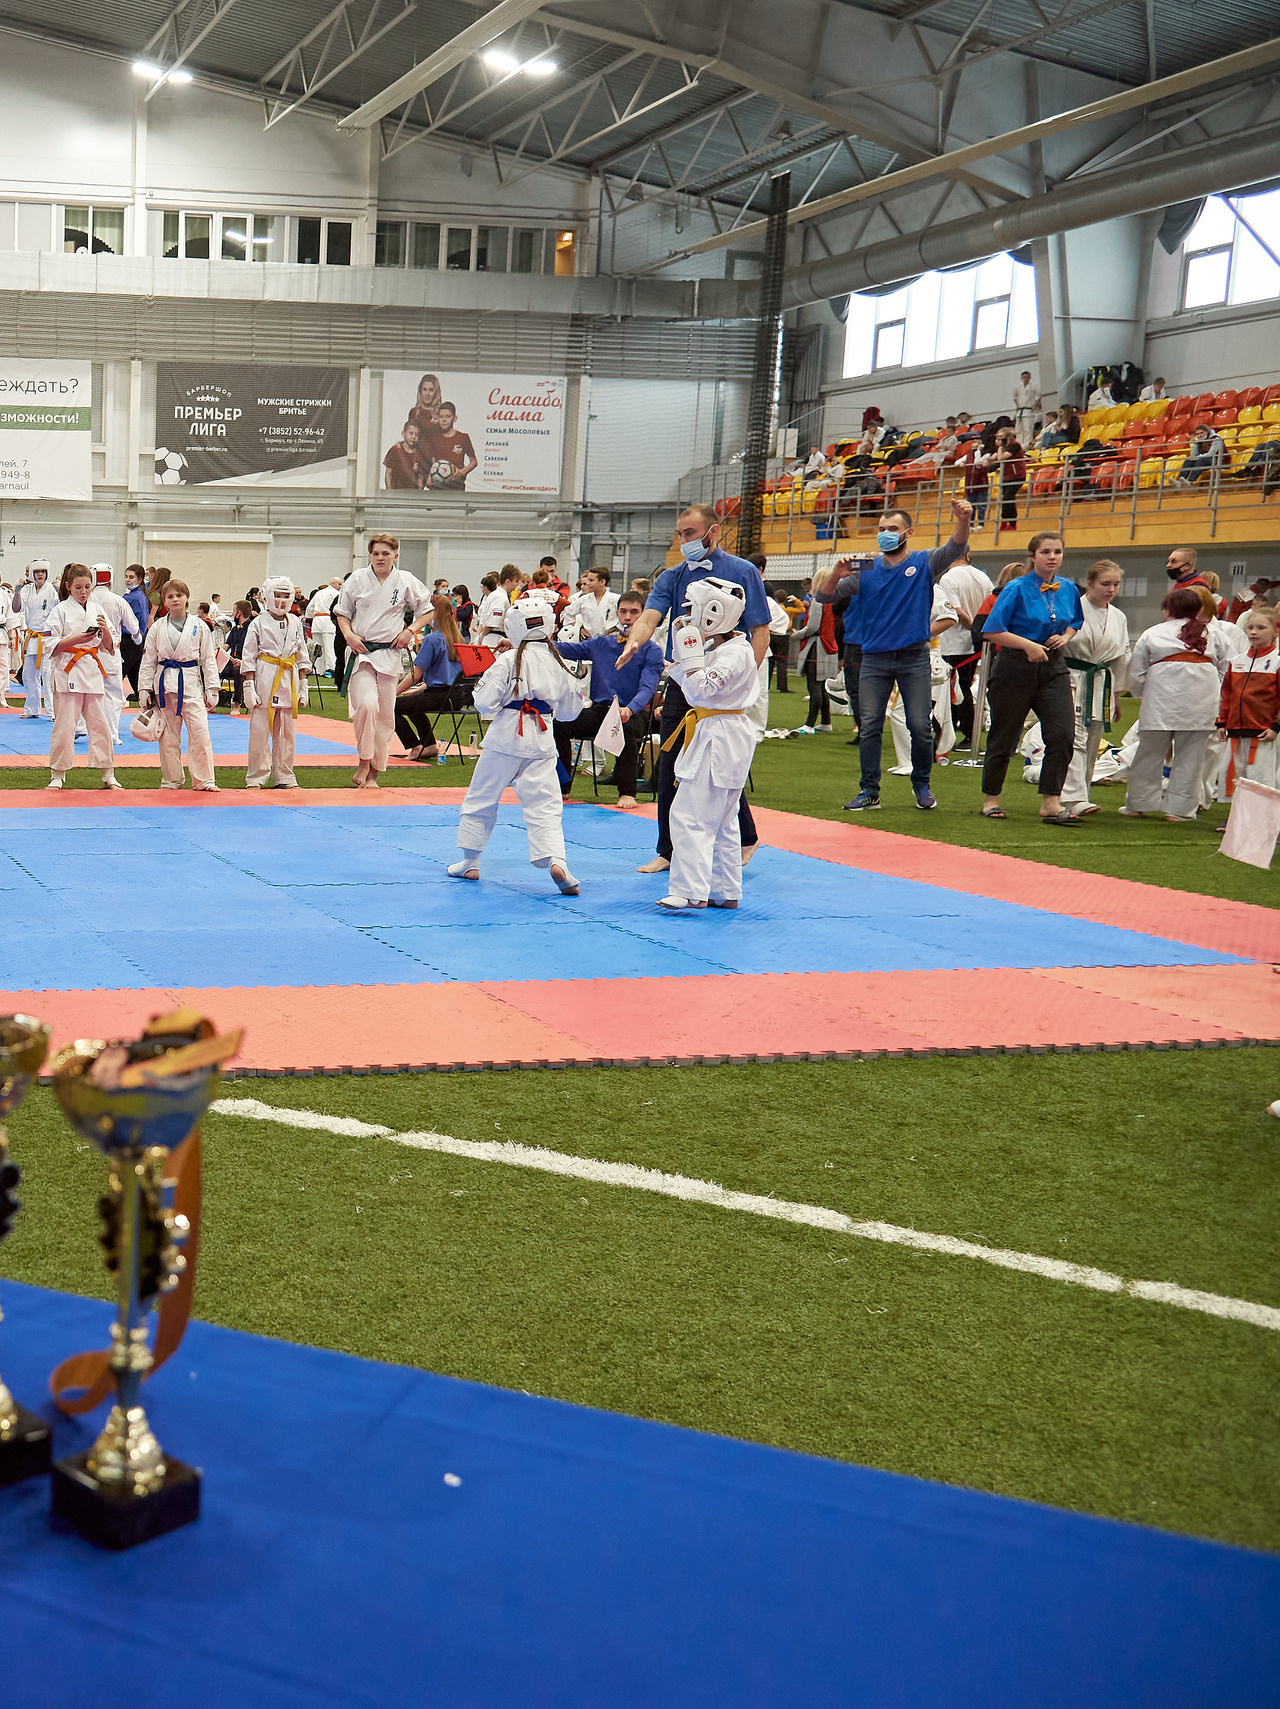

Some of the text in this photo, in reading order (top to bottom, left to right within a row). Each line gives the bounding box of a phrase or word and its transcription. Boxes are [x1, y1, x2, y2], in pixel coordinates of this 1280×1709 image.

[186, 385, 232, 398] БАРБЕРШОП
[257, 398, 332, 407] МУЖСКИЕ СТРИЖКИ
[488, 387, 562, 409] Спасибо,
[174, 406, 242, 420] ПРЕМЬЕР
[278, 408, 307, 416] БРИТЬЕ
[486, 410, 545, 422] мама
[188, 422, 226, 436] ЛИГА
[268, 426, 292, 436] (3852)
[294, 428, 325, 436] 52-96-42
[22, 460, 28, 468] 7
[8, 534, 17, 546] 4
